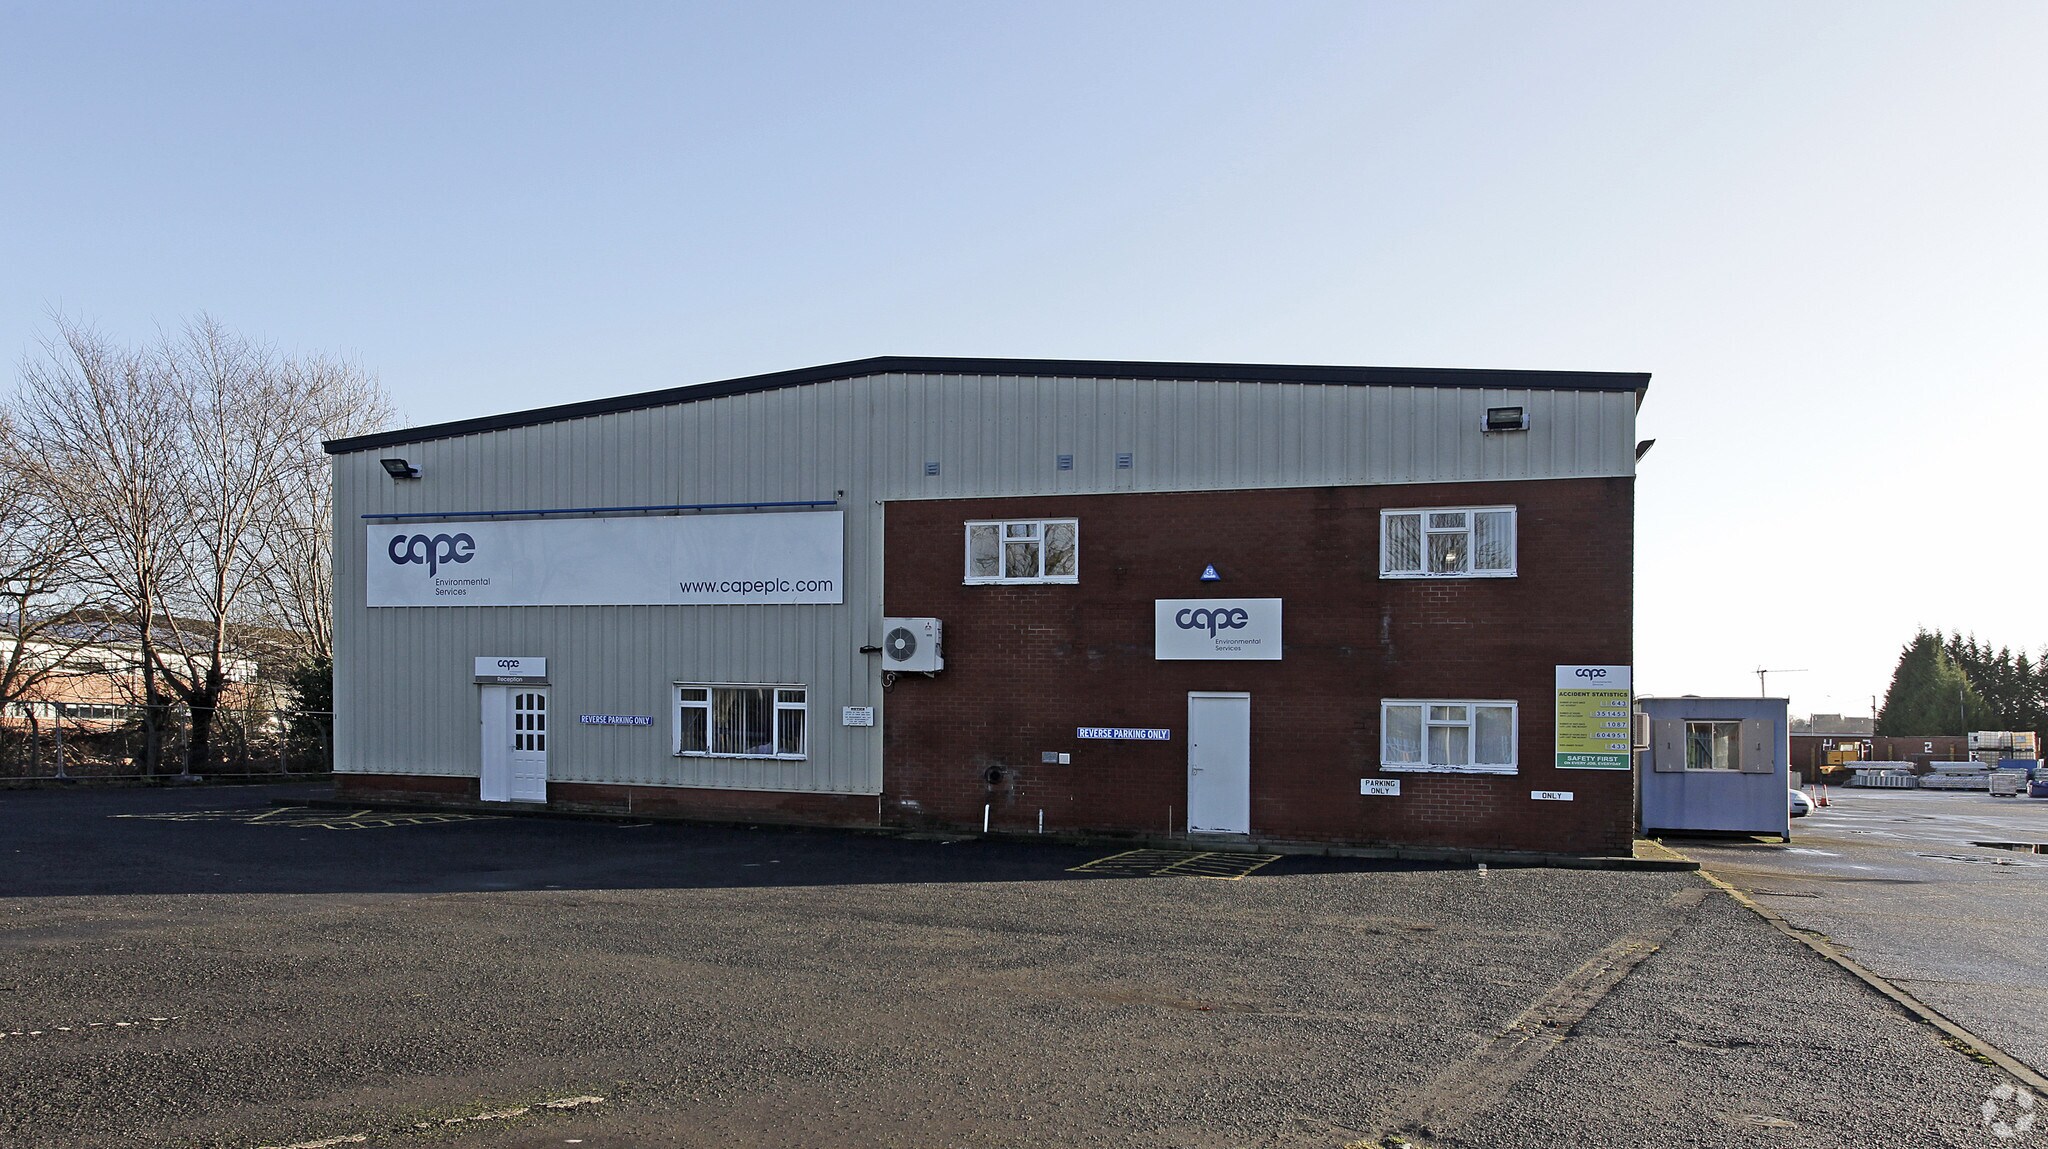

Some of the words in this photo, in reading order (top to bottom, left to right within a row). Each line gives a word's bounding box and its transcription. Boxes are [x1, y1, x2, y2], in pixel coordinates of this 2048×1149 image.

[388, 533, 476, 578] cape
[435, 578, 491, 586] Environmental
[679, 577, 833, 595] www.capeplc.com
[435, 588, 467, 596] Services
[1175, 608, 1248, 639] cape
[497, 660, 520, 670] cape
[1575, 669, 1607, 680] cape
[581, 715, 607, 724] REVERSE
[608, 716, 633, 724] PARKING
[634, 717, 650, 725] ONLY
[1079, 728, 1112, 738] REVERSE
[1113, 729, 1146, 739] PARKING
[1147, 730, 1167, 739] ONLY
[1924, 741, 1933, 753] 2
[1365, 779, 1396, 787] PARKING
[1370, 787, 1390, 795] ONLY
